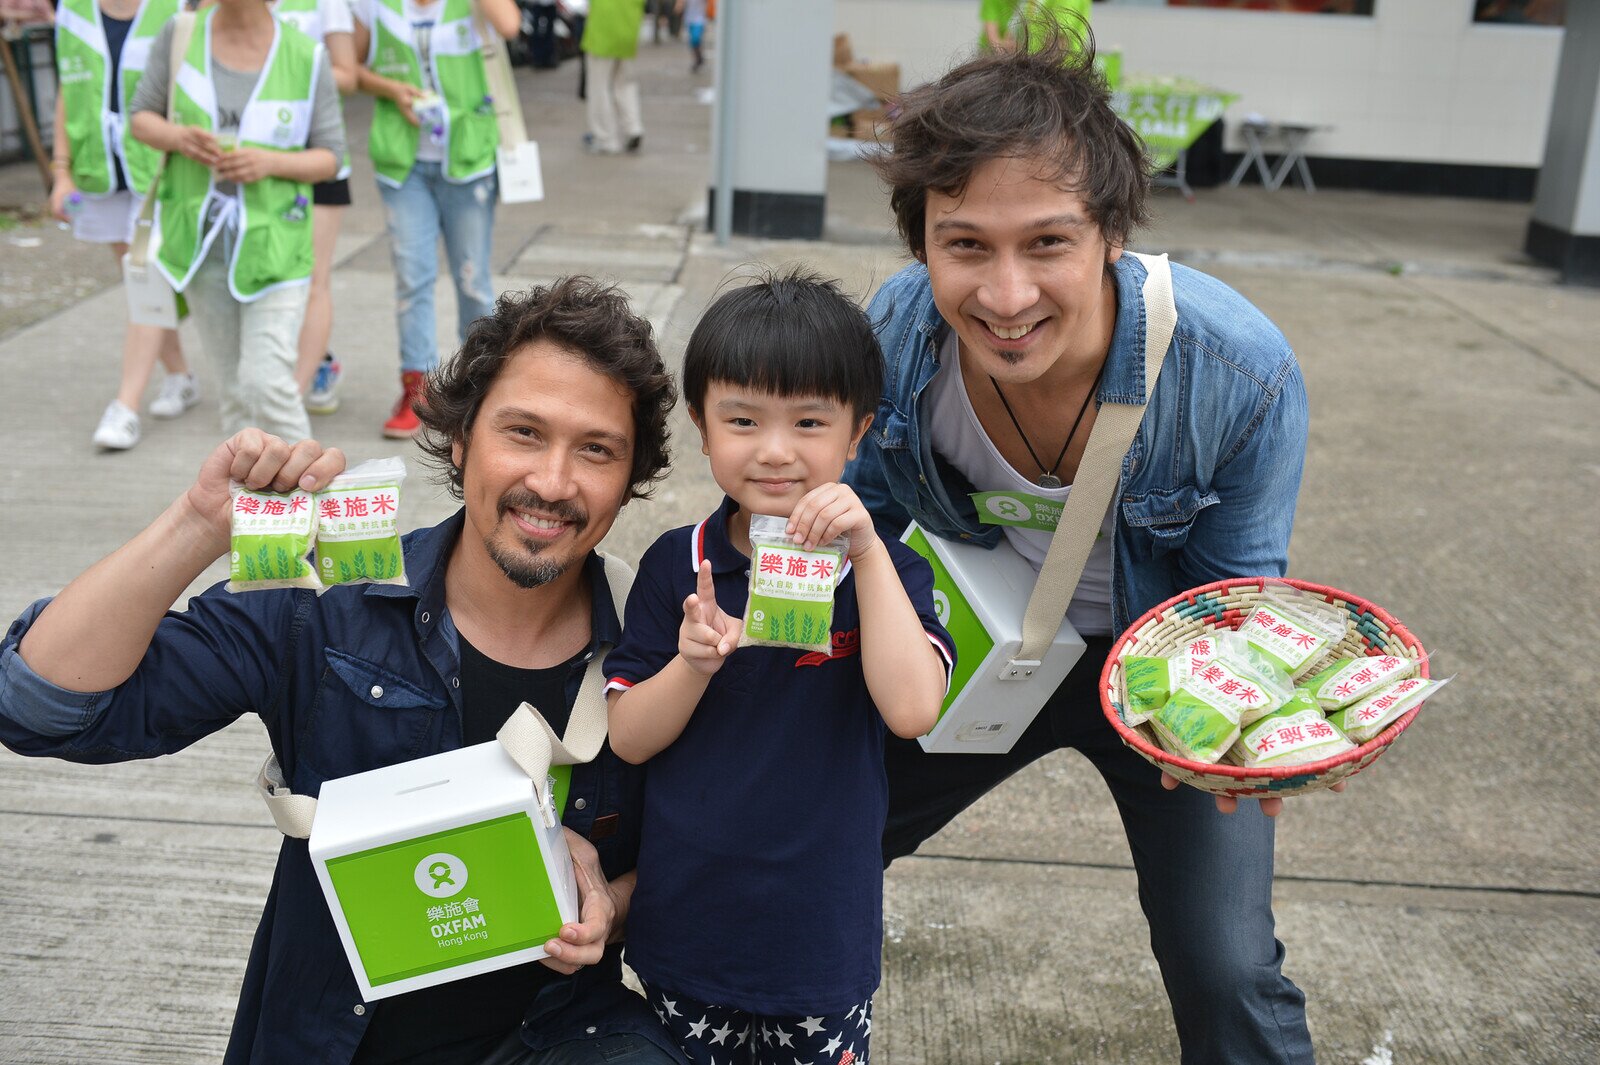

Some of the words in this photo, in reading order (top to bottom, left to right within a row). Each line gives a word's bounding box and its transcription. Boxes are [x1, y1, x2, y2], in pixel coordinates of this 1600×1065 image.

[235, 495, 308, 516] 樂施米
[320, 494, 396, 520] 樂施米
[760, 552, 834, 579] 樂施米
[1252, 611, 1316, 650] 樂施米
[1198, 665, 1260, 703] 樂施米
[1333, 655, 1401, 698] 樂施米
[1358, 680, 1420, 721] 樂施米
[1257, 722, 1333, 752] 樂施米
[426, 897, 480, 922] 樂施會
[430, 913, 487, 938] OXFAM
[437, 937, 463, 948] Hong
[463, 930, 488, 942] Kong
